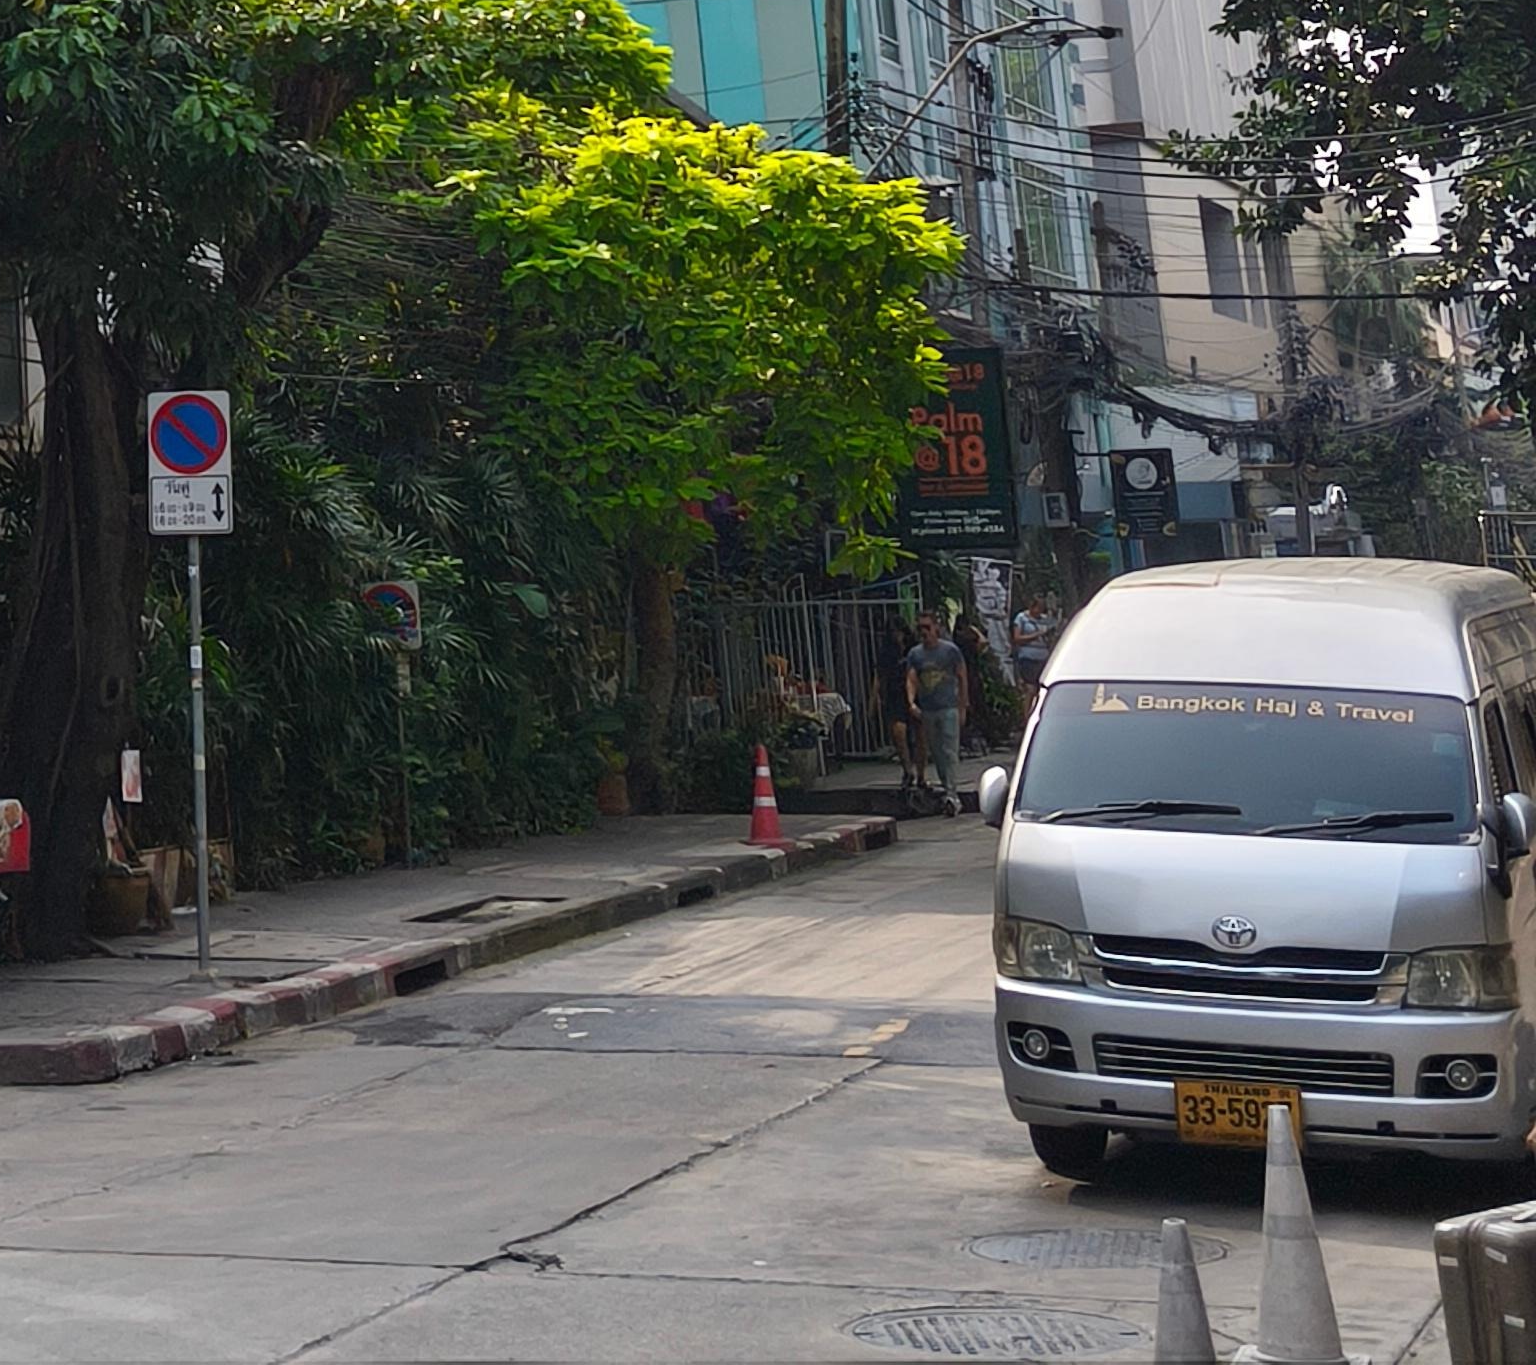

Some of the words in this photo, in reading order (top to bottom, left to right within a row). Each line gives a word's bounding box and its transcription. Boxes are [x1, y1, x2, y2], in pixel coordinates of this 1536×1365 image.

[908, 400, 984, 432] Palm
[1136, 695, 1246, 714] Bangkok
[1254, 698, 1297, 717] Haj
[1306, 701, 1325, 717] &
[1335, 702, 1415, 724] Travel
[1204, 1084, 1271, 1096] THAILAND
